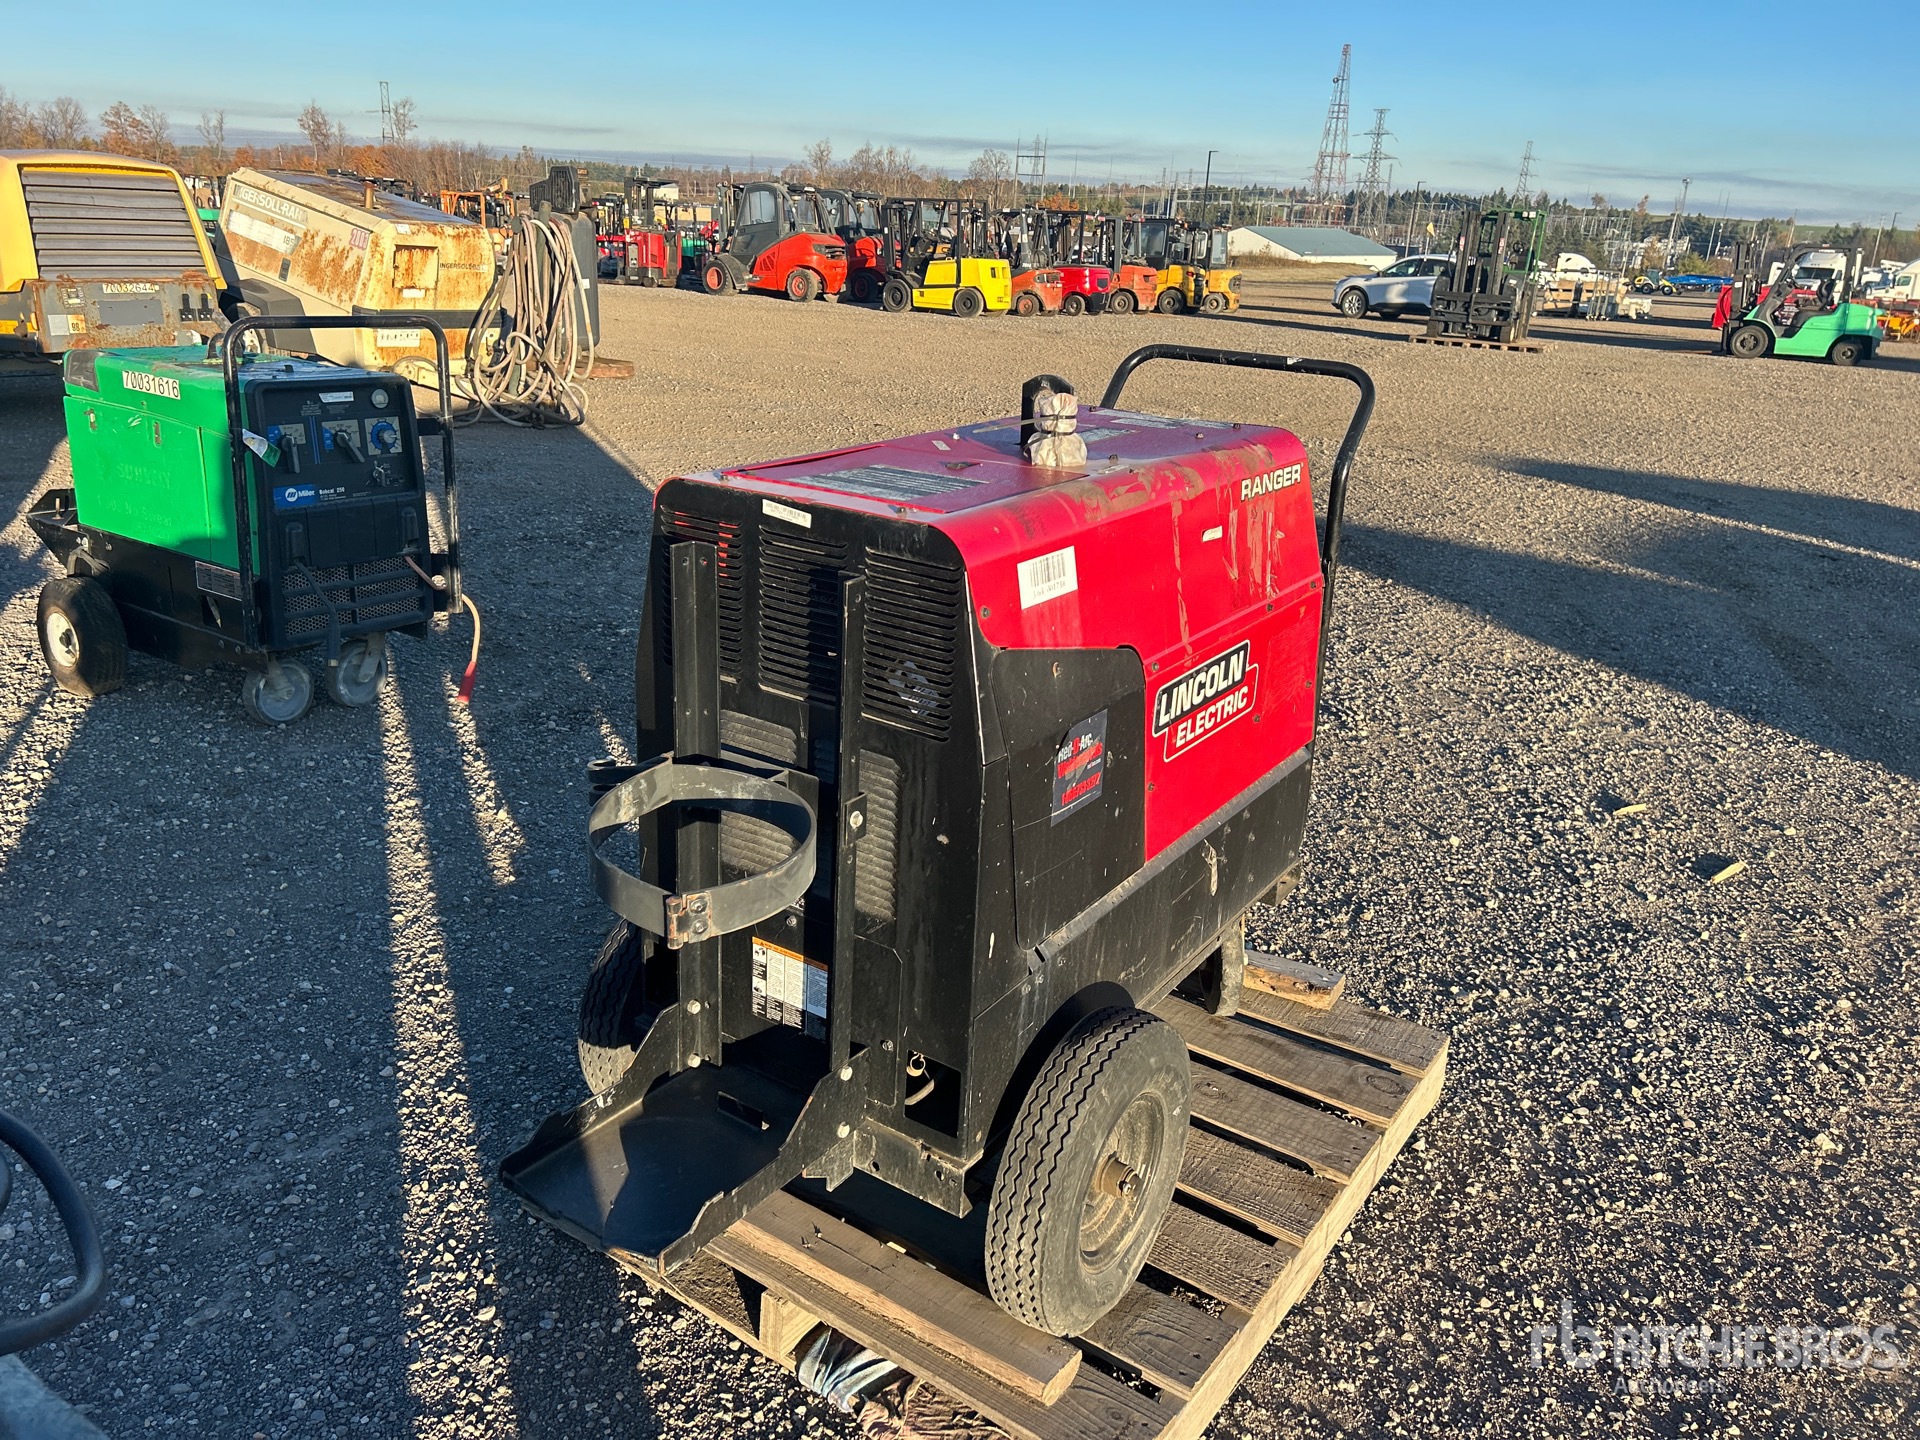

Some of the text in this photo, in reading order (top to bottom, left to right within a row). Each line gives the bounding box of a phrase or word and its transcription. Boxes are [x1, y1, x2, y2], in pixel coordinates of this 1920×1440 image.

[104, 283, 154, 293] 70032644
[124, 370, 179, 398] 70031616
[298, 489, 316, 498] Miller
[1241, 463, 1301, 502] RANGER
[1159, 650, 1245, 727] LINCOLN
[1175, 686, 1248, 748] ELECTRIC
